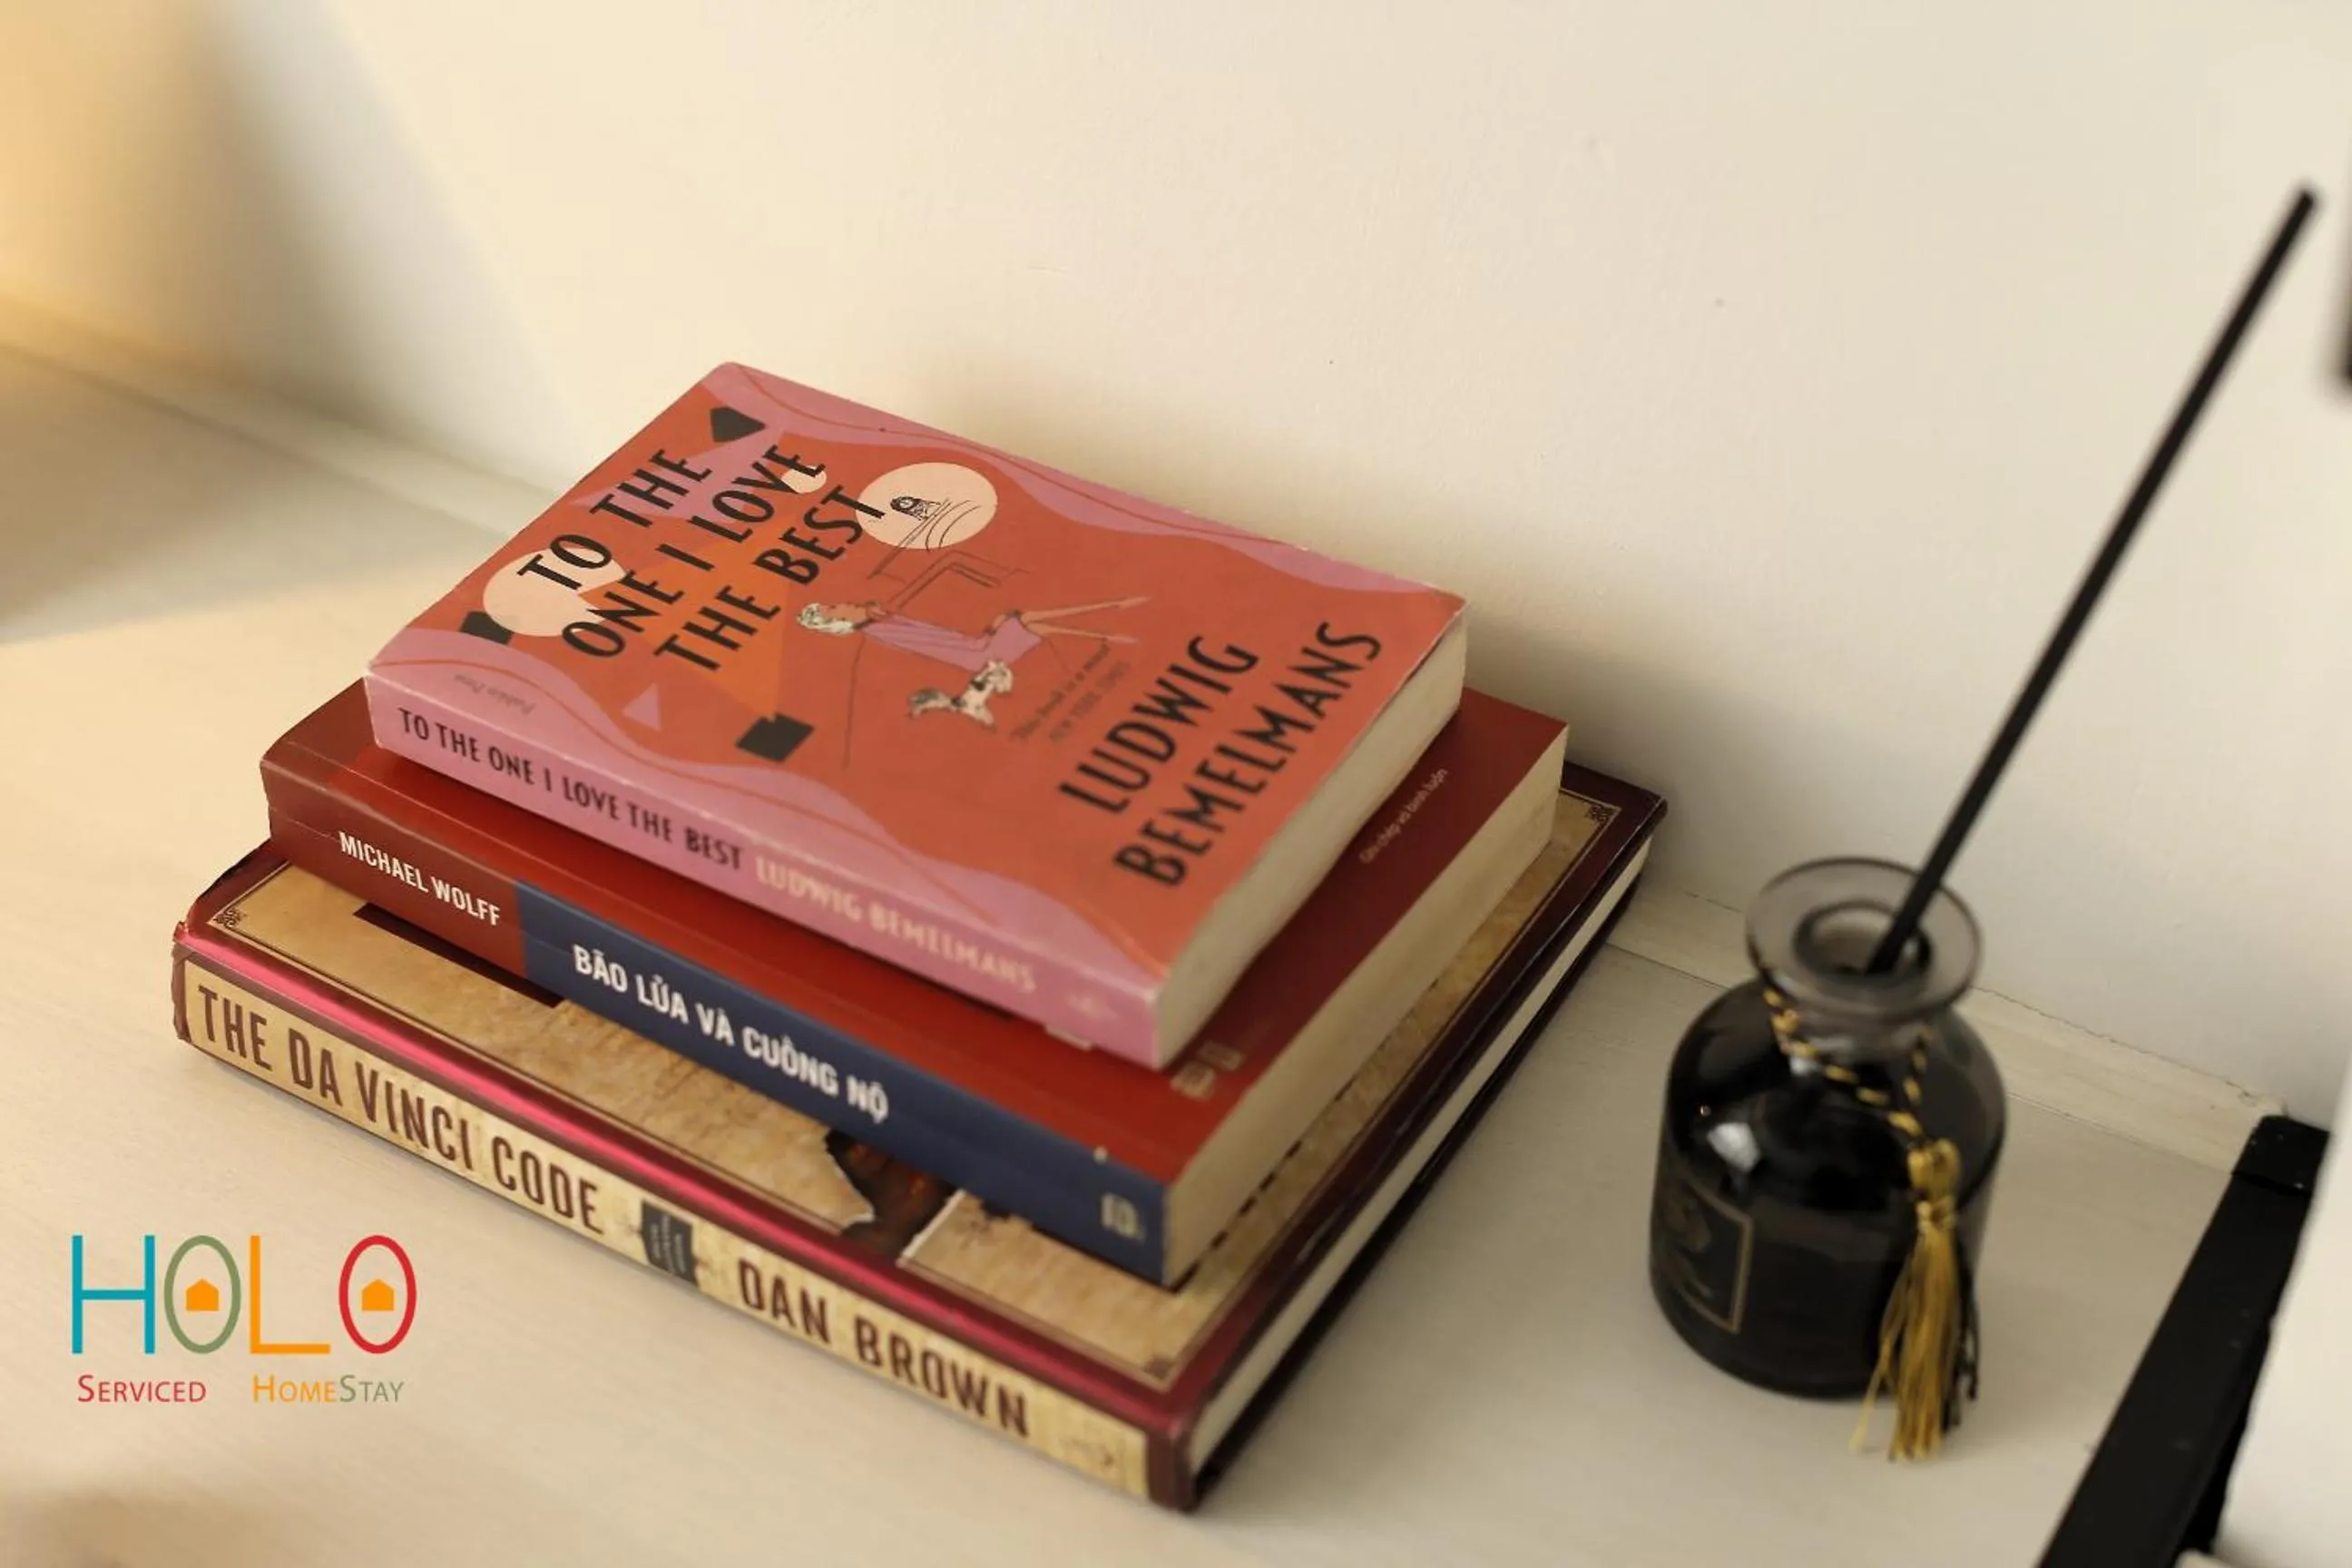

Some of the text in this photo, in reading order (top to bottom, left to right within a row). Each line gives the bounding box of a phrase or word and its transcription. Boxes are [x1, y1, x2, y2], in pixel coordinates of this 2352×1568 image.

[518, 448, 712, 589] TO THE
[561, 444, 826, 658] ONE I LOVE
[653, 485, 887, 671] THE BEST
[1058, 635, 1259, 815] LUDWIG
[1112, 621, 1383, 887] BEMELMANS
[338, 830, 501, 926] MICHAEL WOLFF
[397, 707, 1038, 994] TO THE ONE I LOVE THE BEST LUDWIG BEMELMANS
[198, 985, 1029, 1439] THE DA VINCI CODE DAN BROWN
